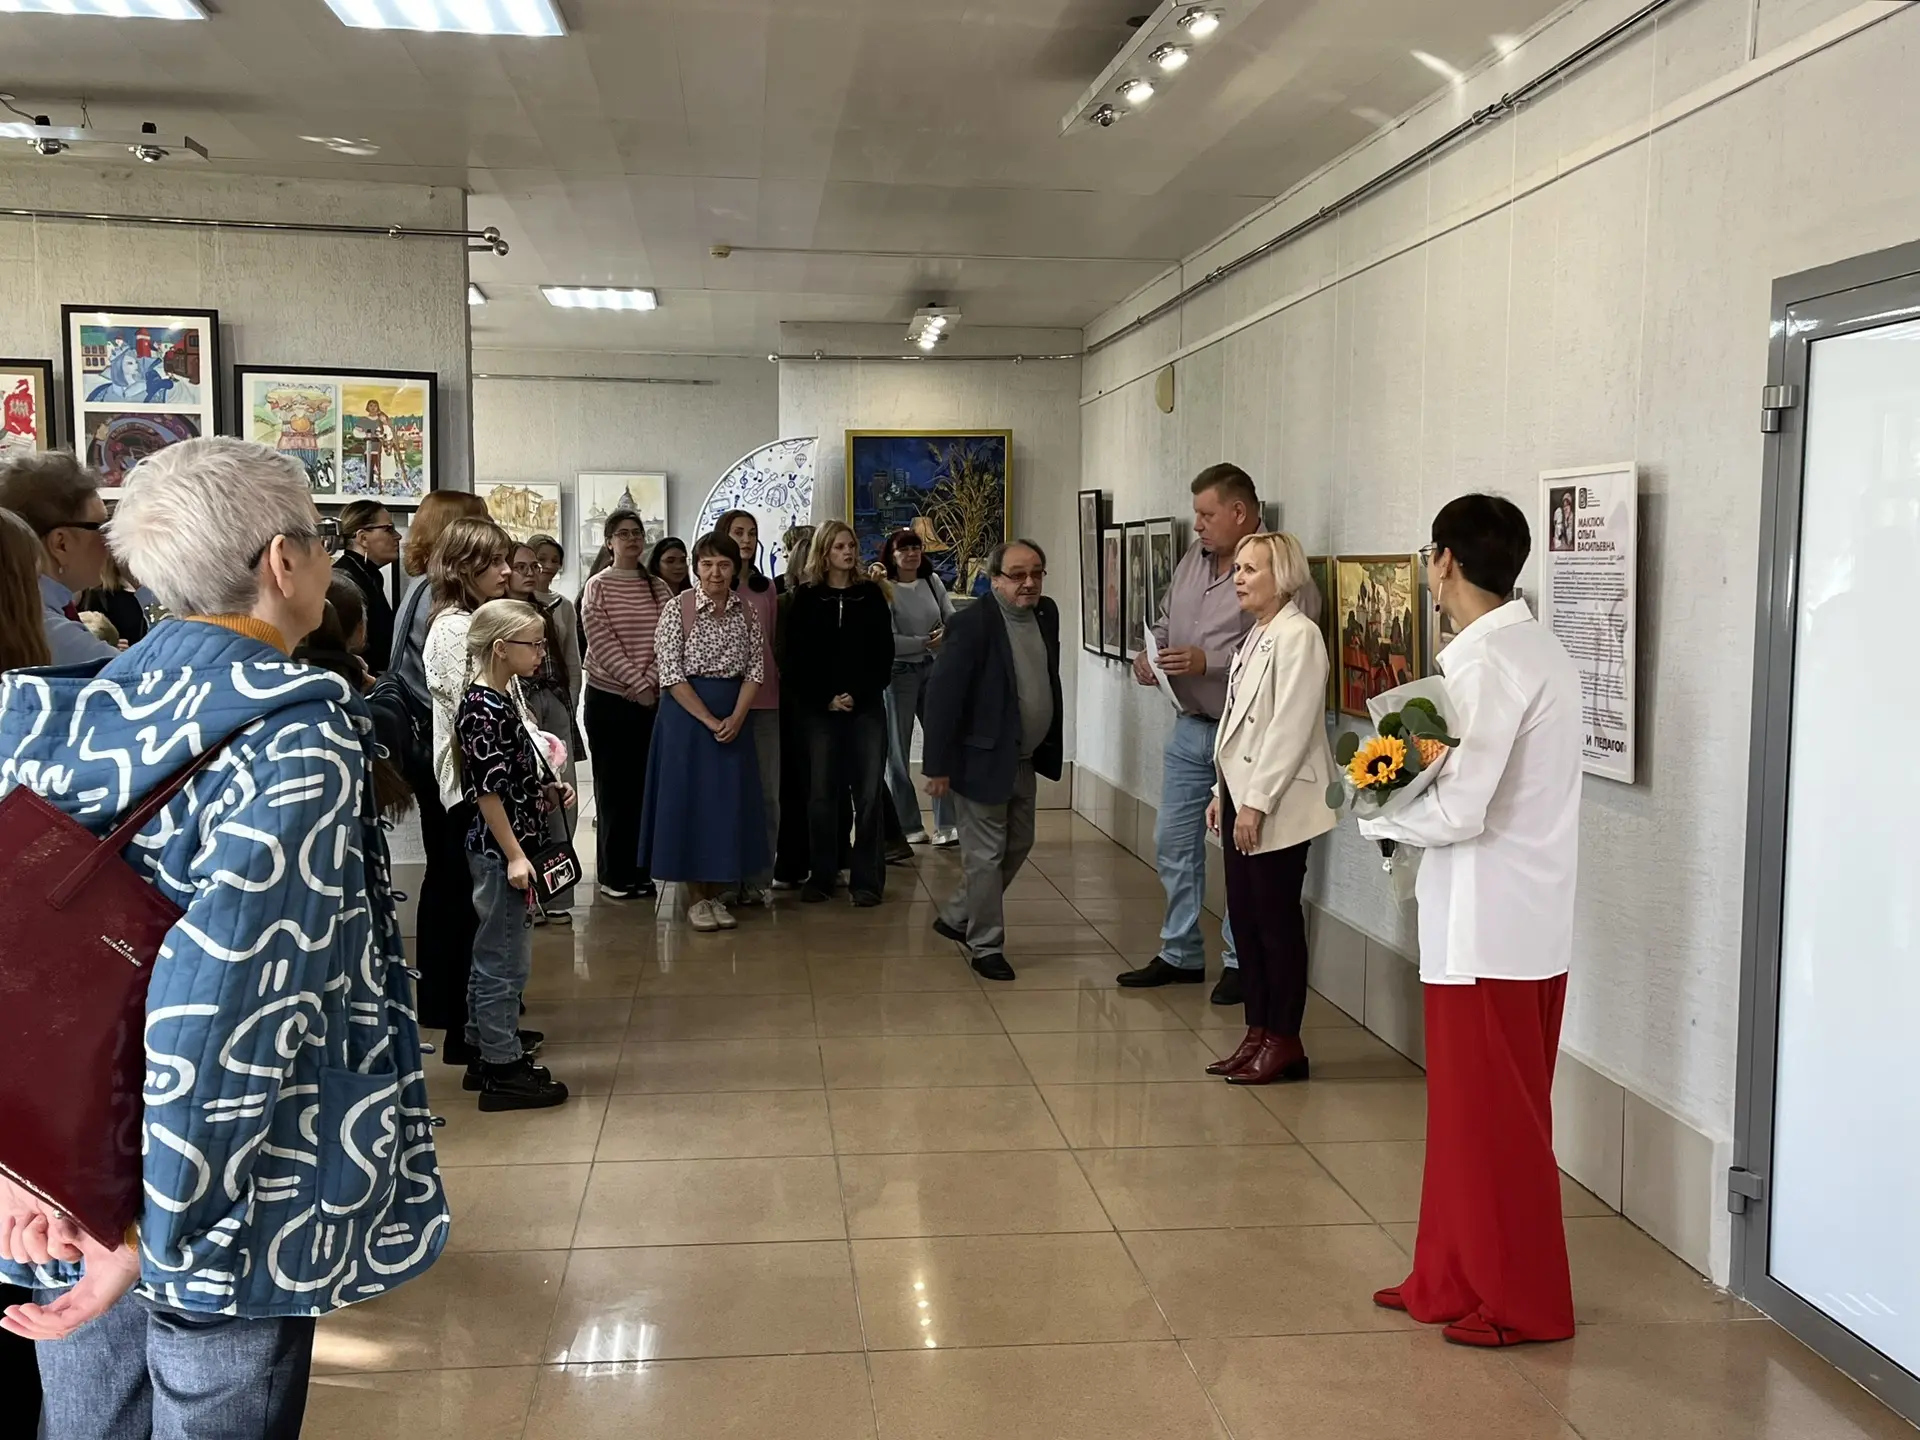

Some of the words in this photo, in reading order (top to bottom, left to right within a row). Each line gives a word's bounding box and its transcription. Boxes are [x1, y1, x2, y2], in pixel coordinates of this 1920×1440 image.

[1577, 529, 1597, 540] ОЛЬГА
[1577, 541, 1616, 552] ВАСИЛЬЕВНА
[1586, 734, 1592, 746] И
[1594, 736, 1624, 753] ПЕДАГОГ
